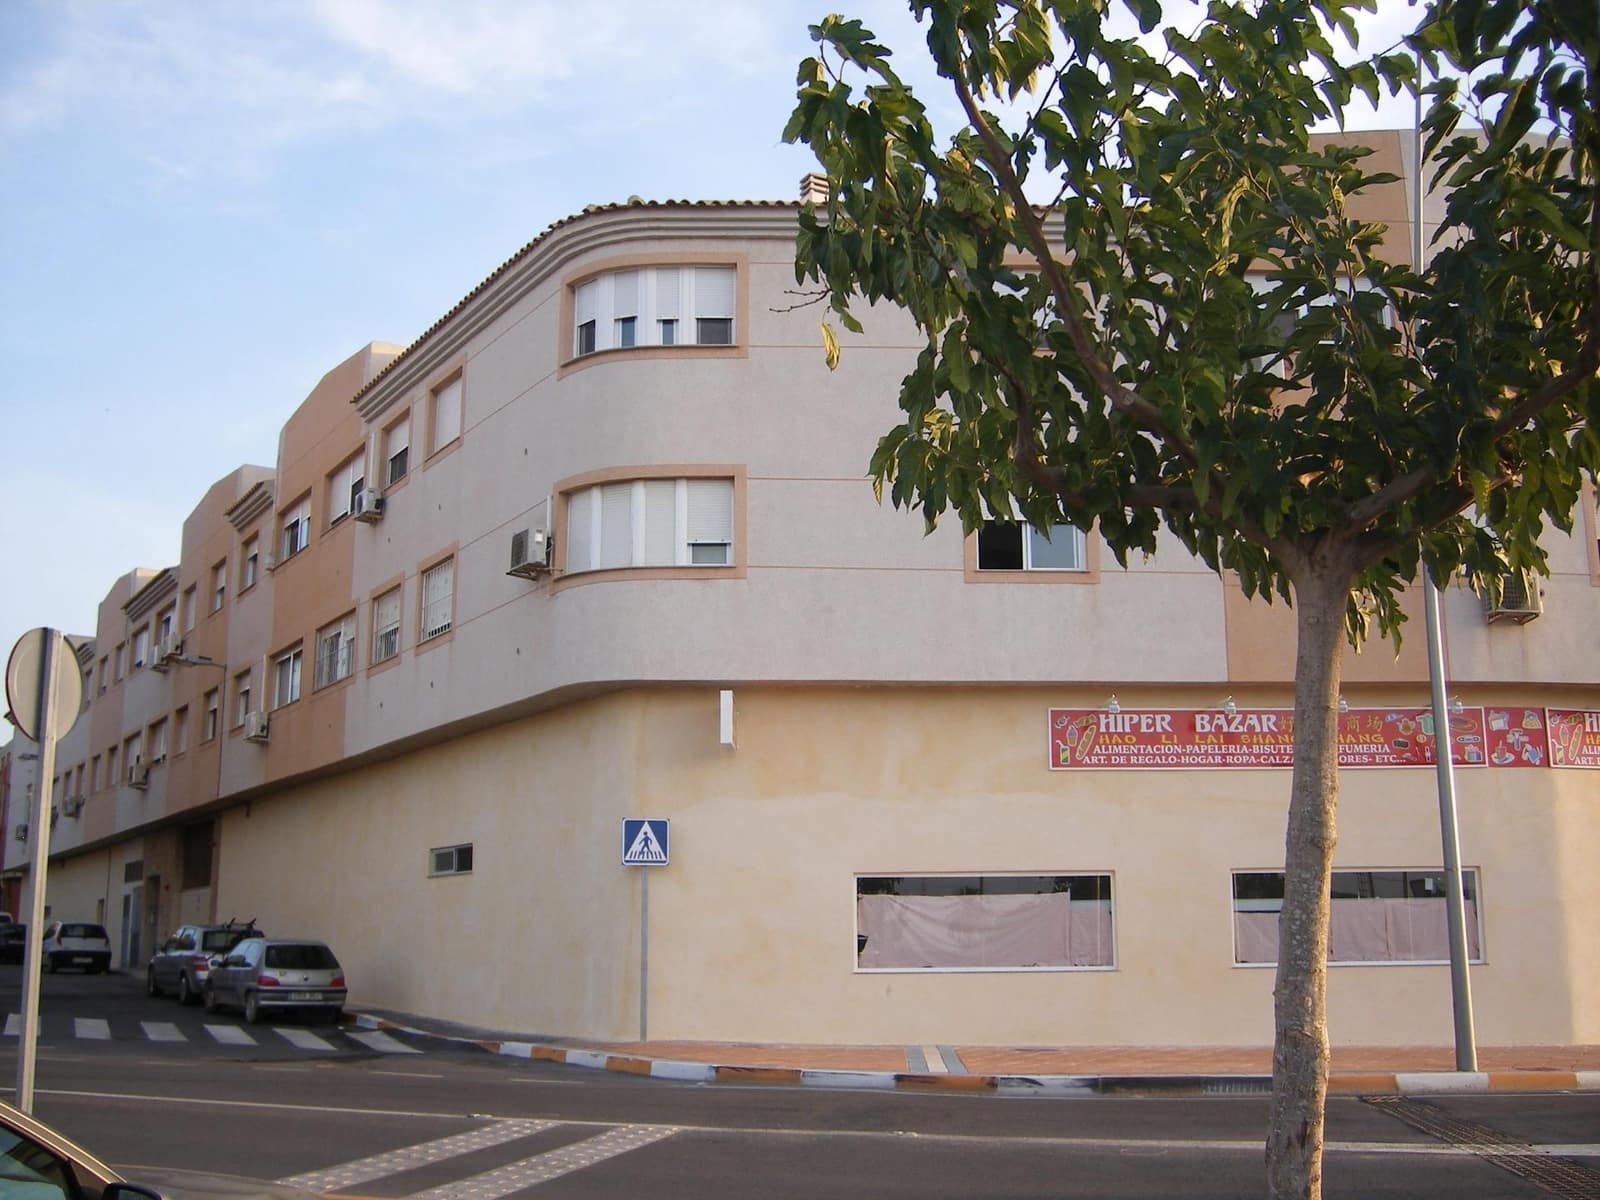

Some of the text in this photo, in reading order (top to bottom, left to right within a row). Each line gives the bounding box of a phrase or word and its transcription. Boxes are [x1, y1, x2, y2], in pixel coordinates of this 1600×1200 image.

[1099, 714, 1278, 733] HIPER BAZAR
[1099, 734, 1137, 744] HAO
[1161, 734, 1178, 744] LI
[1195, 734, 1225, 744] LAI
[1082, 755, 1108, 764] ART.
[1111, 755, 1128, 764] DE
